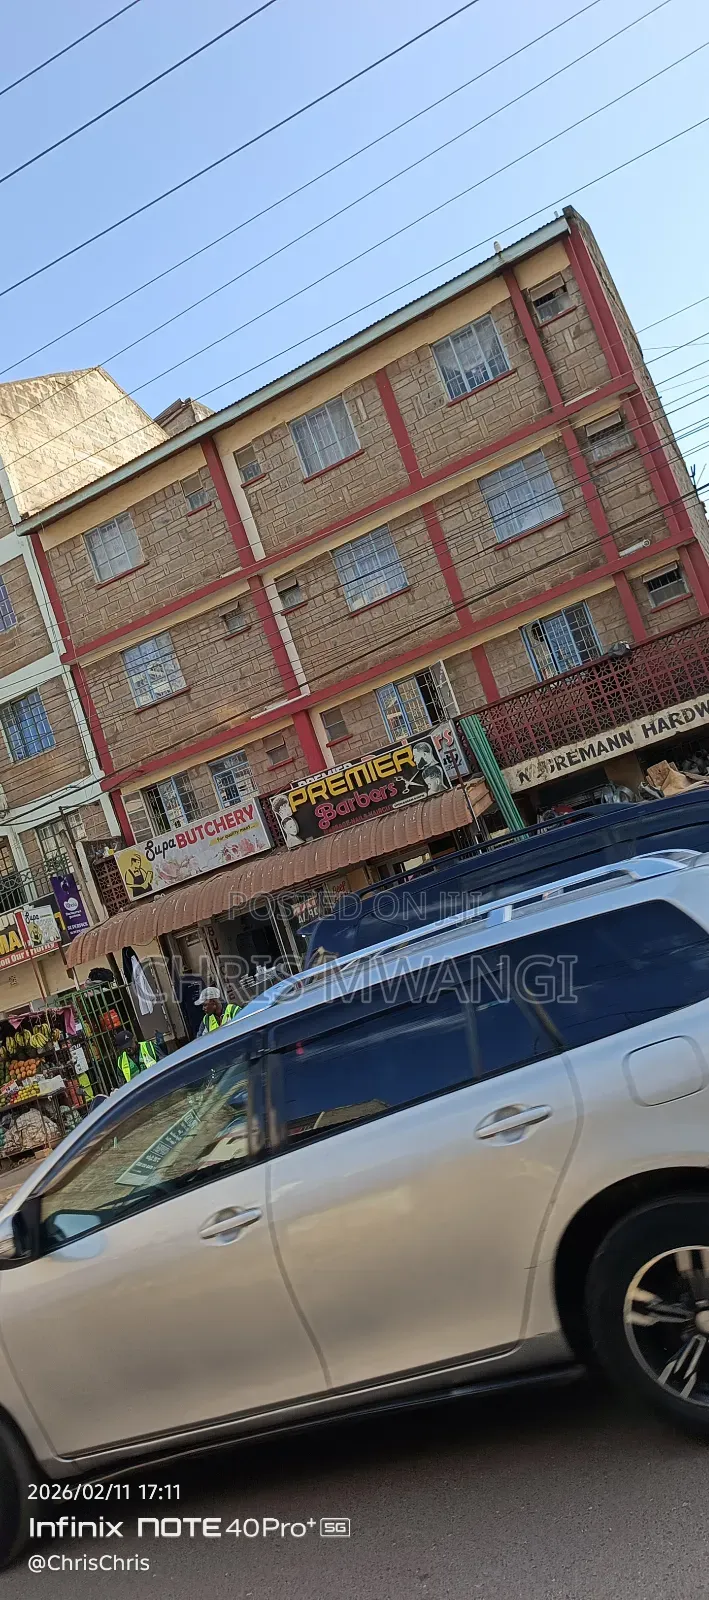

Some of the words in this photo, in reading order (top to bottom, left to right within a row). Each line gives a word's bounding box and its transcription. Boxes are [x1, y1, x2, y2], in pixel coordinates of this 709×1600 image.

[288, 745, 416, 812] PREMIER
[314, 782, 398, 830] Barbers
[145, 839, 176, 862] Supa
[175, 804, 254, 849] BUTCHERY
[12, 950, 25, 962] Our
